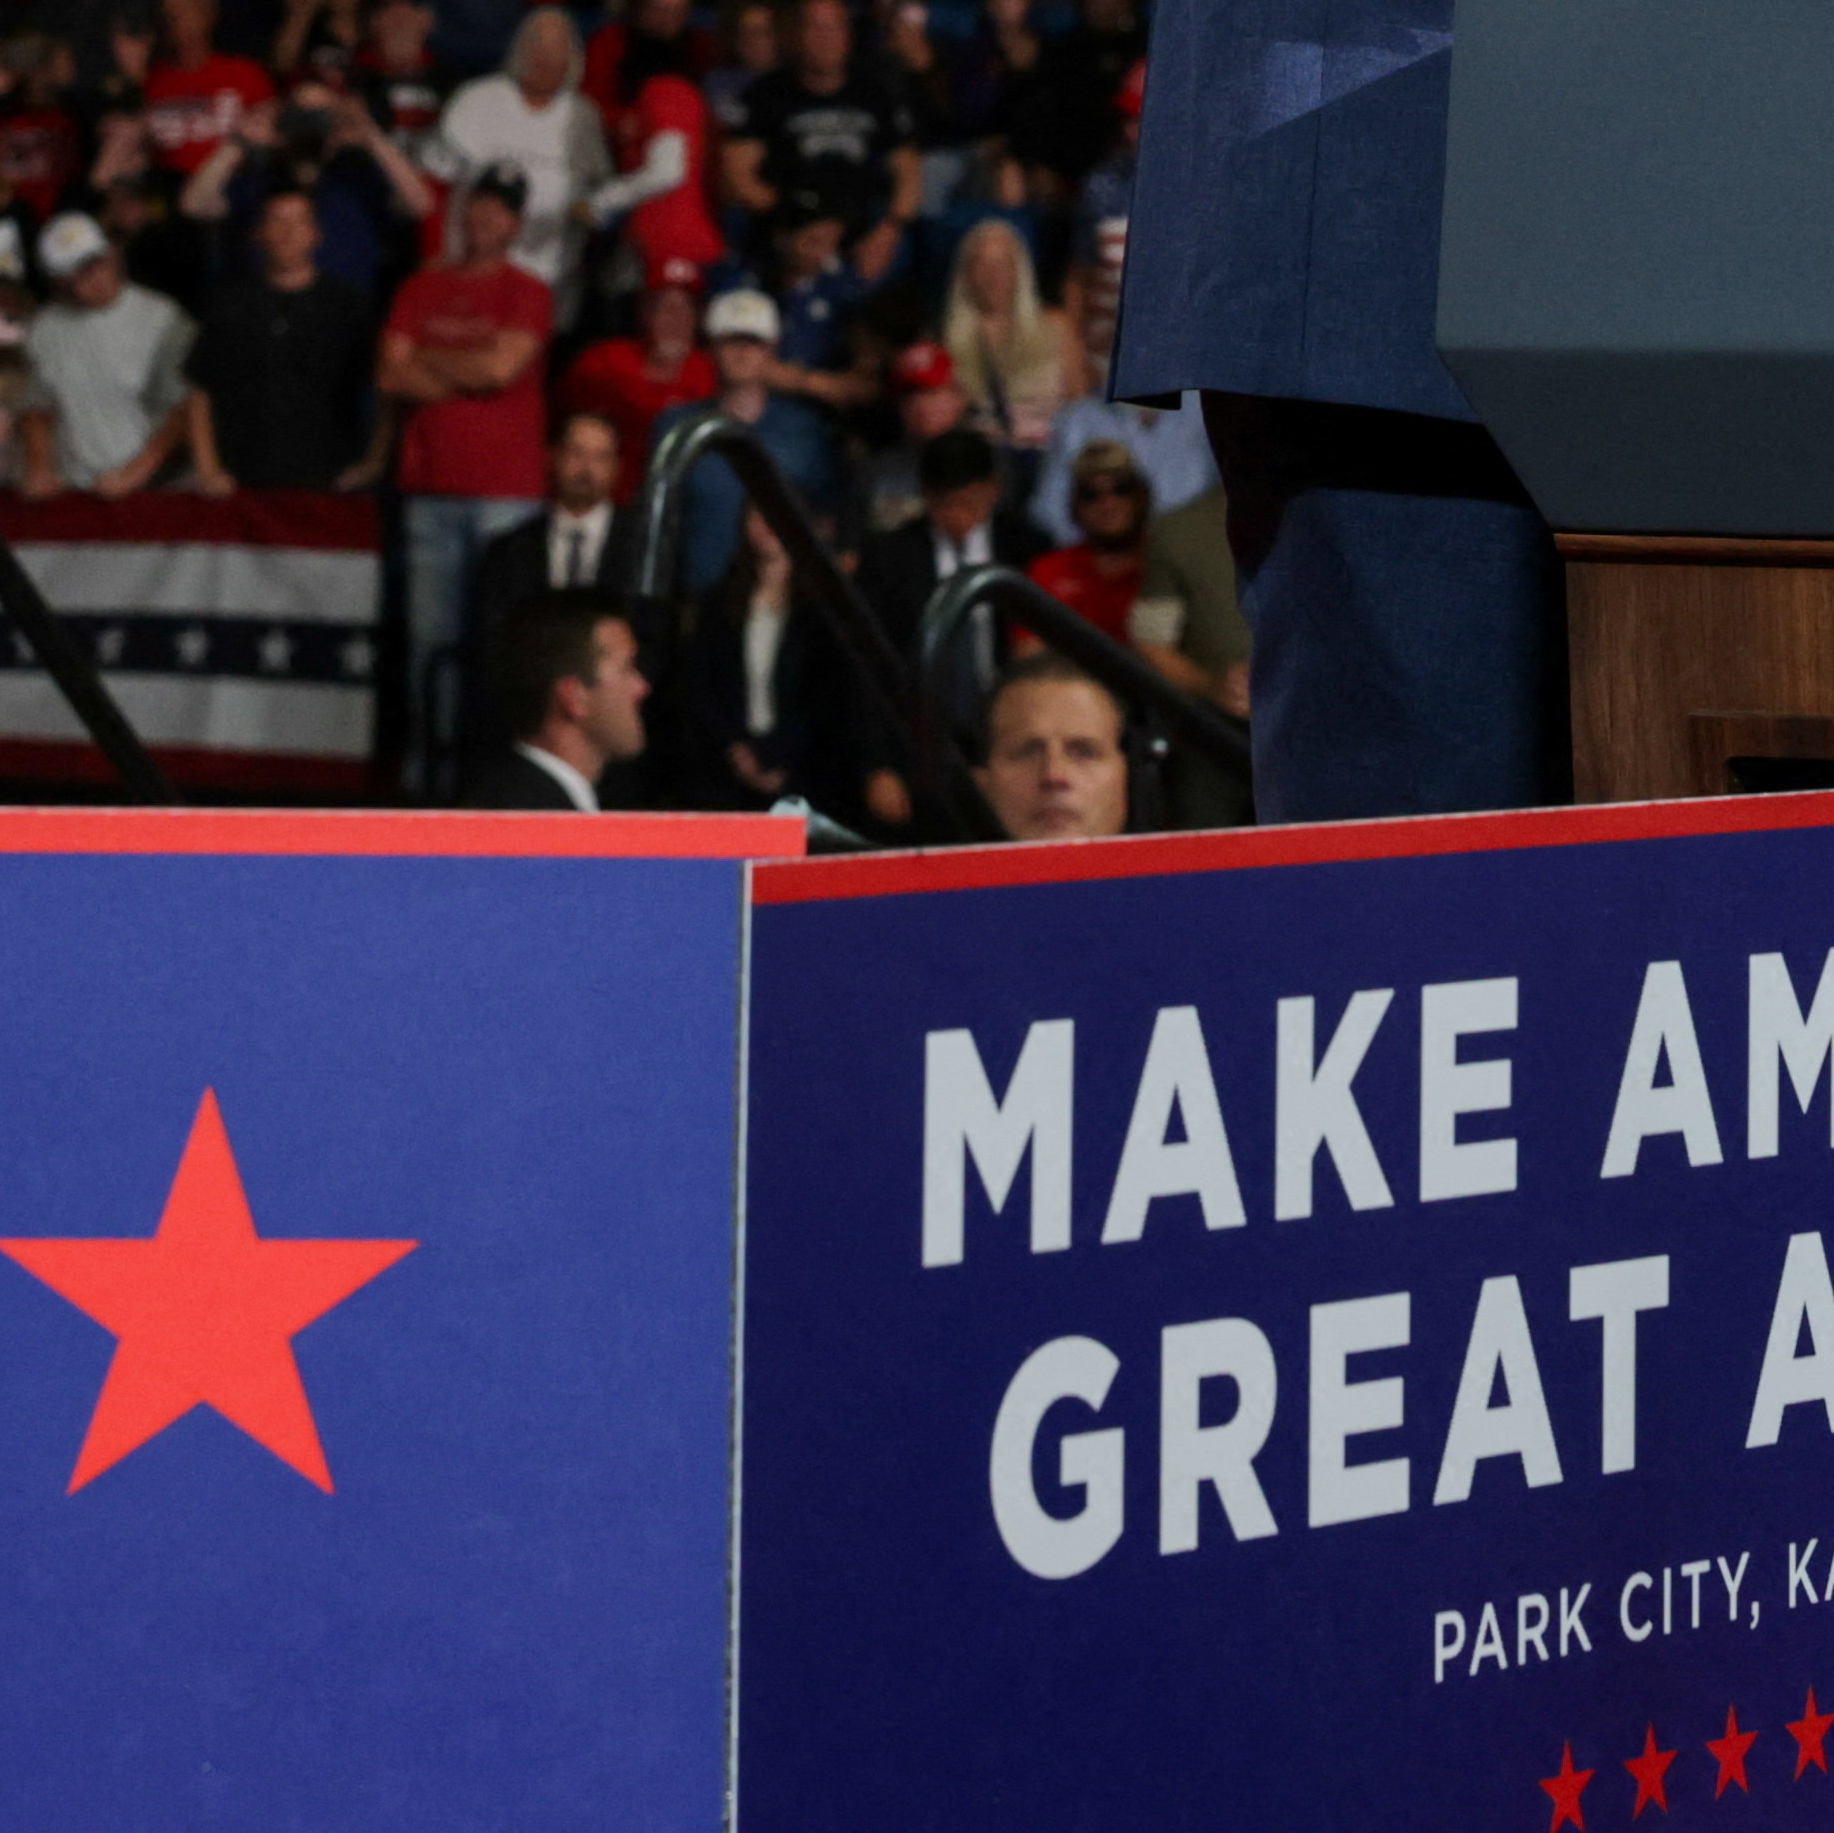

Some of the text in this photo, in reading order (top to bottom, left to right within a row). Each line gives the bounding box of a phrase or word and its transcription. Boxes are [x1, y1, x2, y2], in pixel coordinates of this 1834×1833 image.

[922, 976, 1519, 1268] MAKE
[990, 1254, 1670, 1579] GREAT
[1434, 1583, 1592, 1683] PARK
[1620, 1551, 1760, 1643] CITY,
